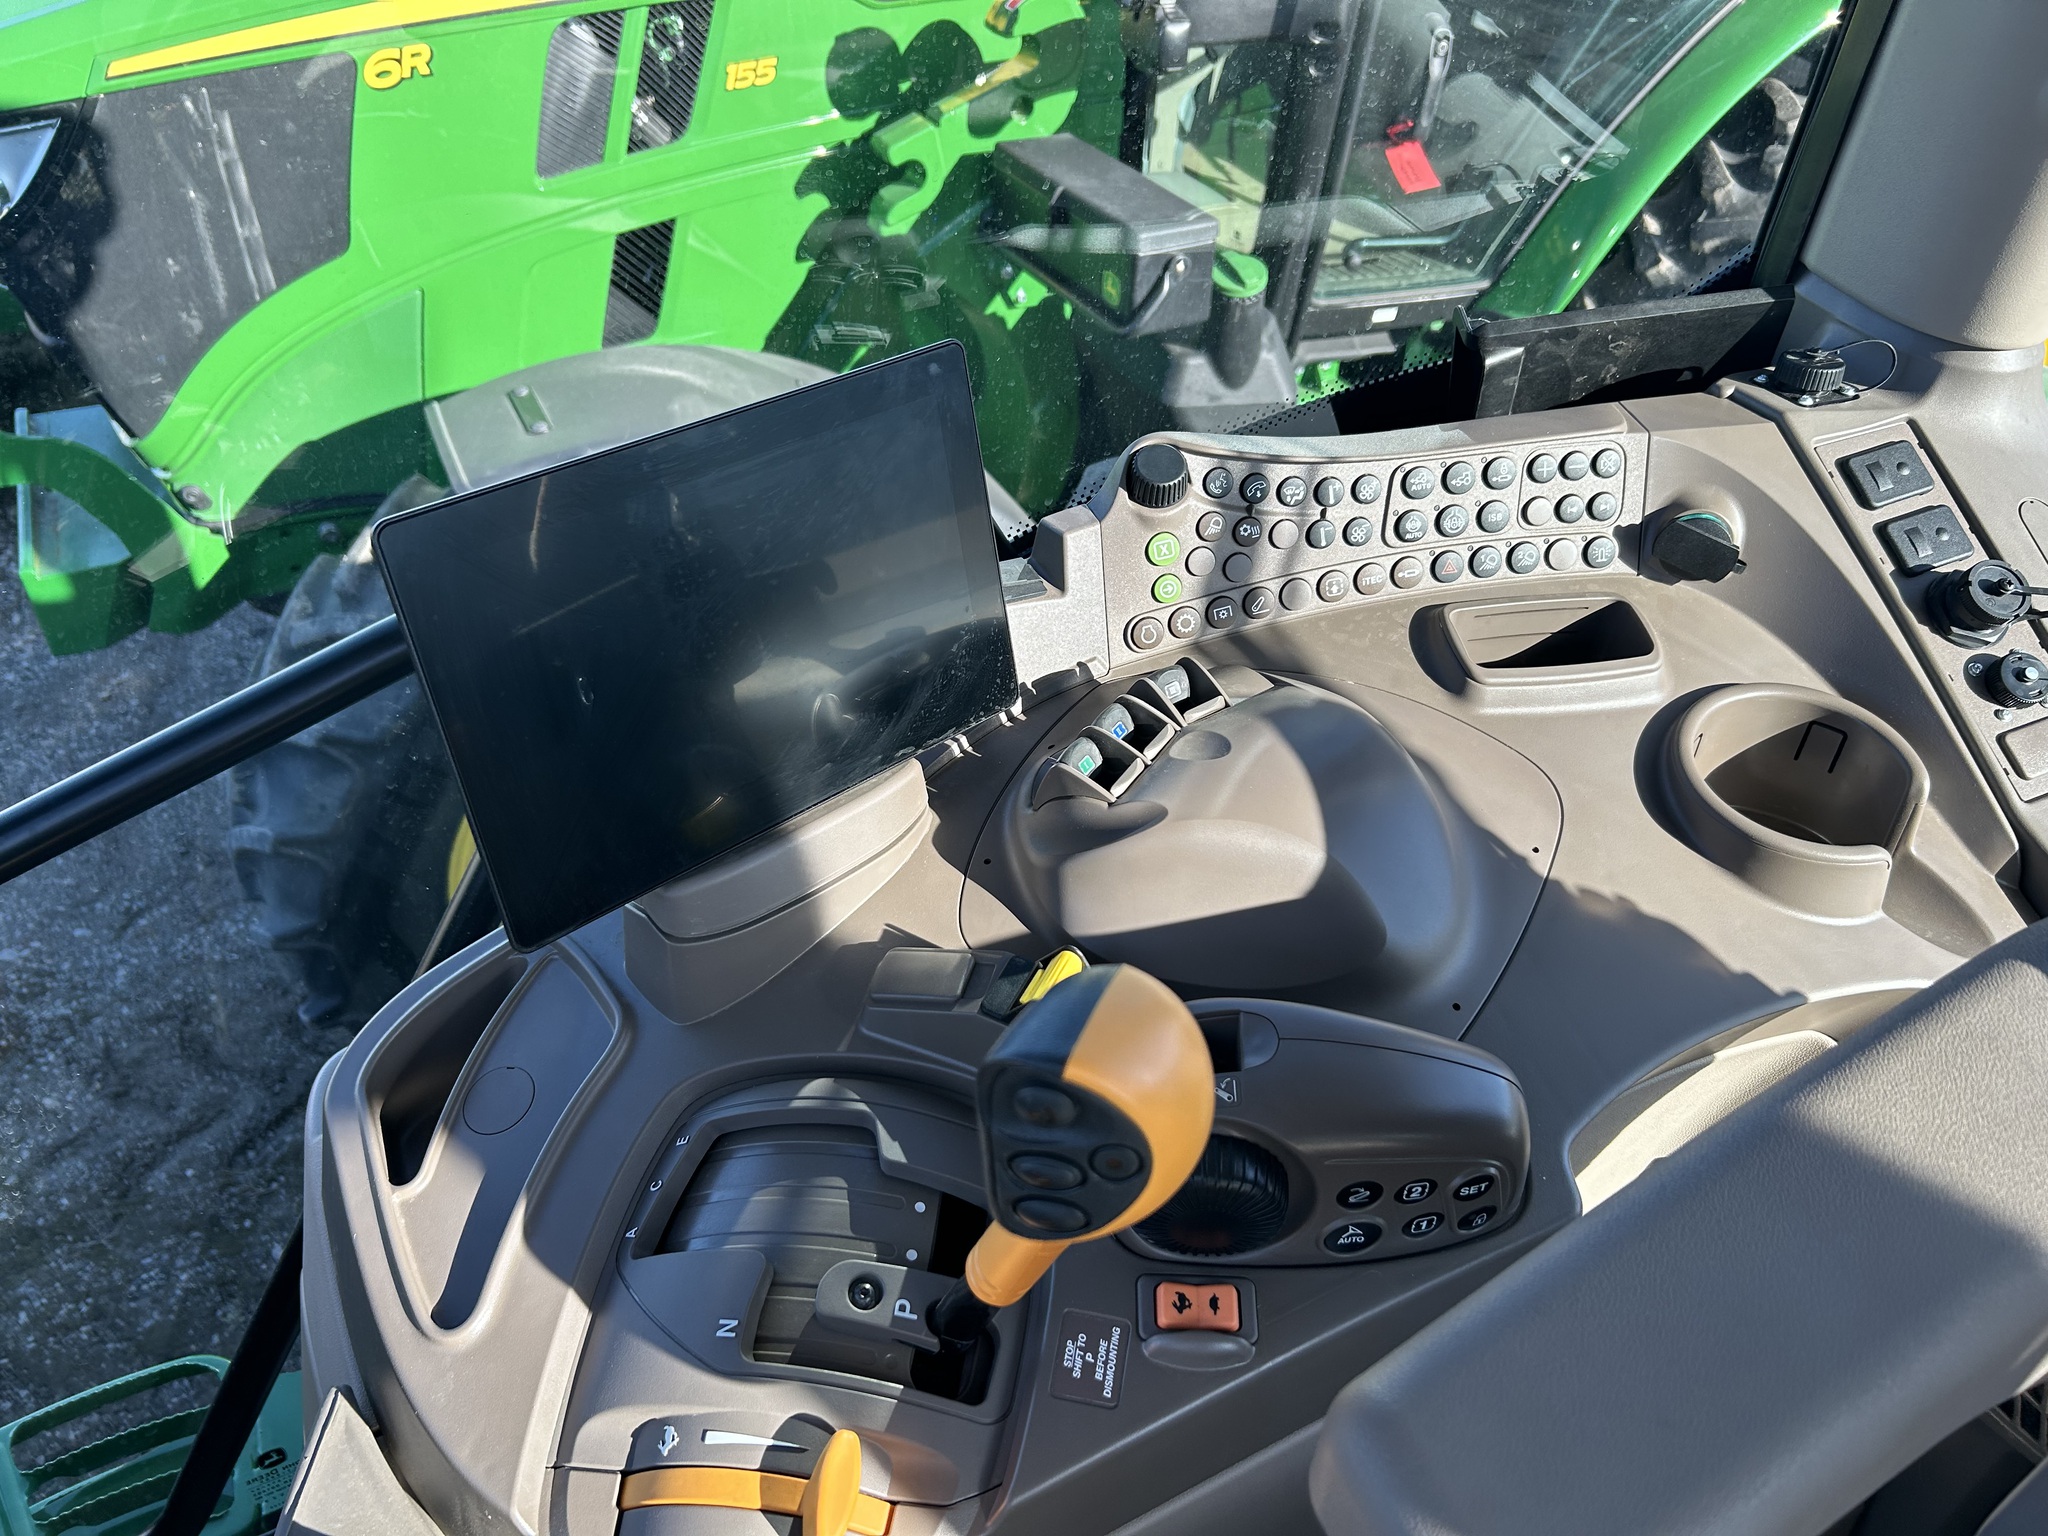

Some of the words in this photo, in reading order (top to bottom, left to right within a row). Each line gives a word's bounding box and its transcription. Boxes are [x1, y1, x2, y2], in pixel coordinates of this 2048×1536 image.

[363, 43, 433, 90] 6R
[725, 56, 778, 91] 155
[1411, 483, 1432, 491] AUTO
[1488, 513, 1503, 522] ISB
[1404, 532, 1423, 540] AUTO
[1480, 554, 1486, 563] 1
[1517, 551, 1524, 559] 2
[1362, 575, 1383, 586] iTEC
[675, 1135, 690, 1146] E
[650, 1180, 662, 1191] C
[1459, 1182, 1489, 1196] SET
[1409, 1186, 1422, 1198] 2
[1420, 1220, 1428, 1230] 1
[625, 1226, 638, 1238] A
[1337, 1236, 1365, 1245] AUTO
[894, 1298, 918, 1320] P
[716, 1318, 739, 1338] N
[1077, 1333, 1087, 1348] TO
[1063, 1340, 1075, 1368] STOP
[1085, 1352, 1095, 1363] P
[1095, 1338, 1108, 1381] BEFORE
[1072, 1348, 1084, 1379] SHIFT
[1103, 1326, 1120, 1398] DISMOUNTING
